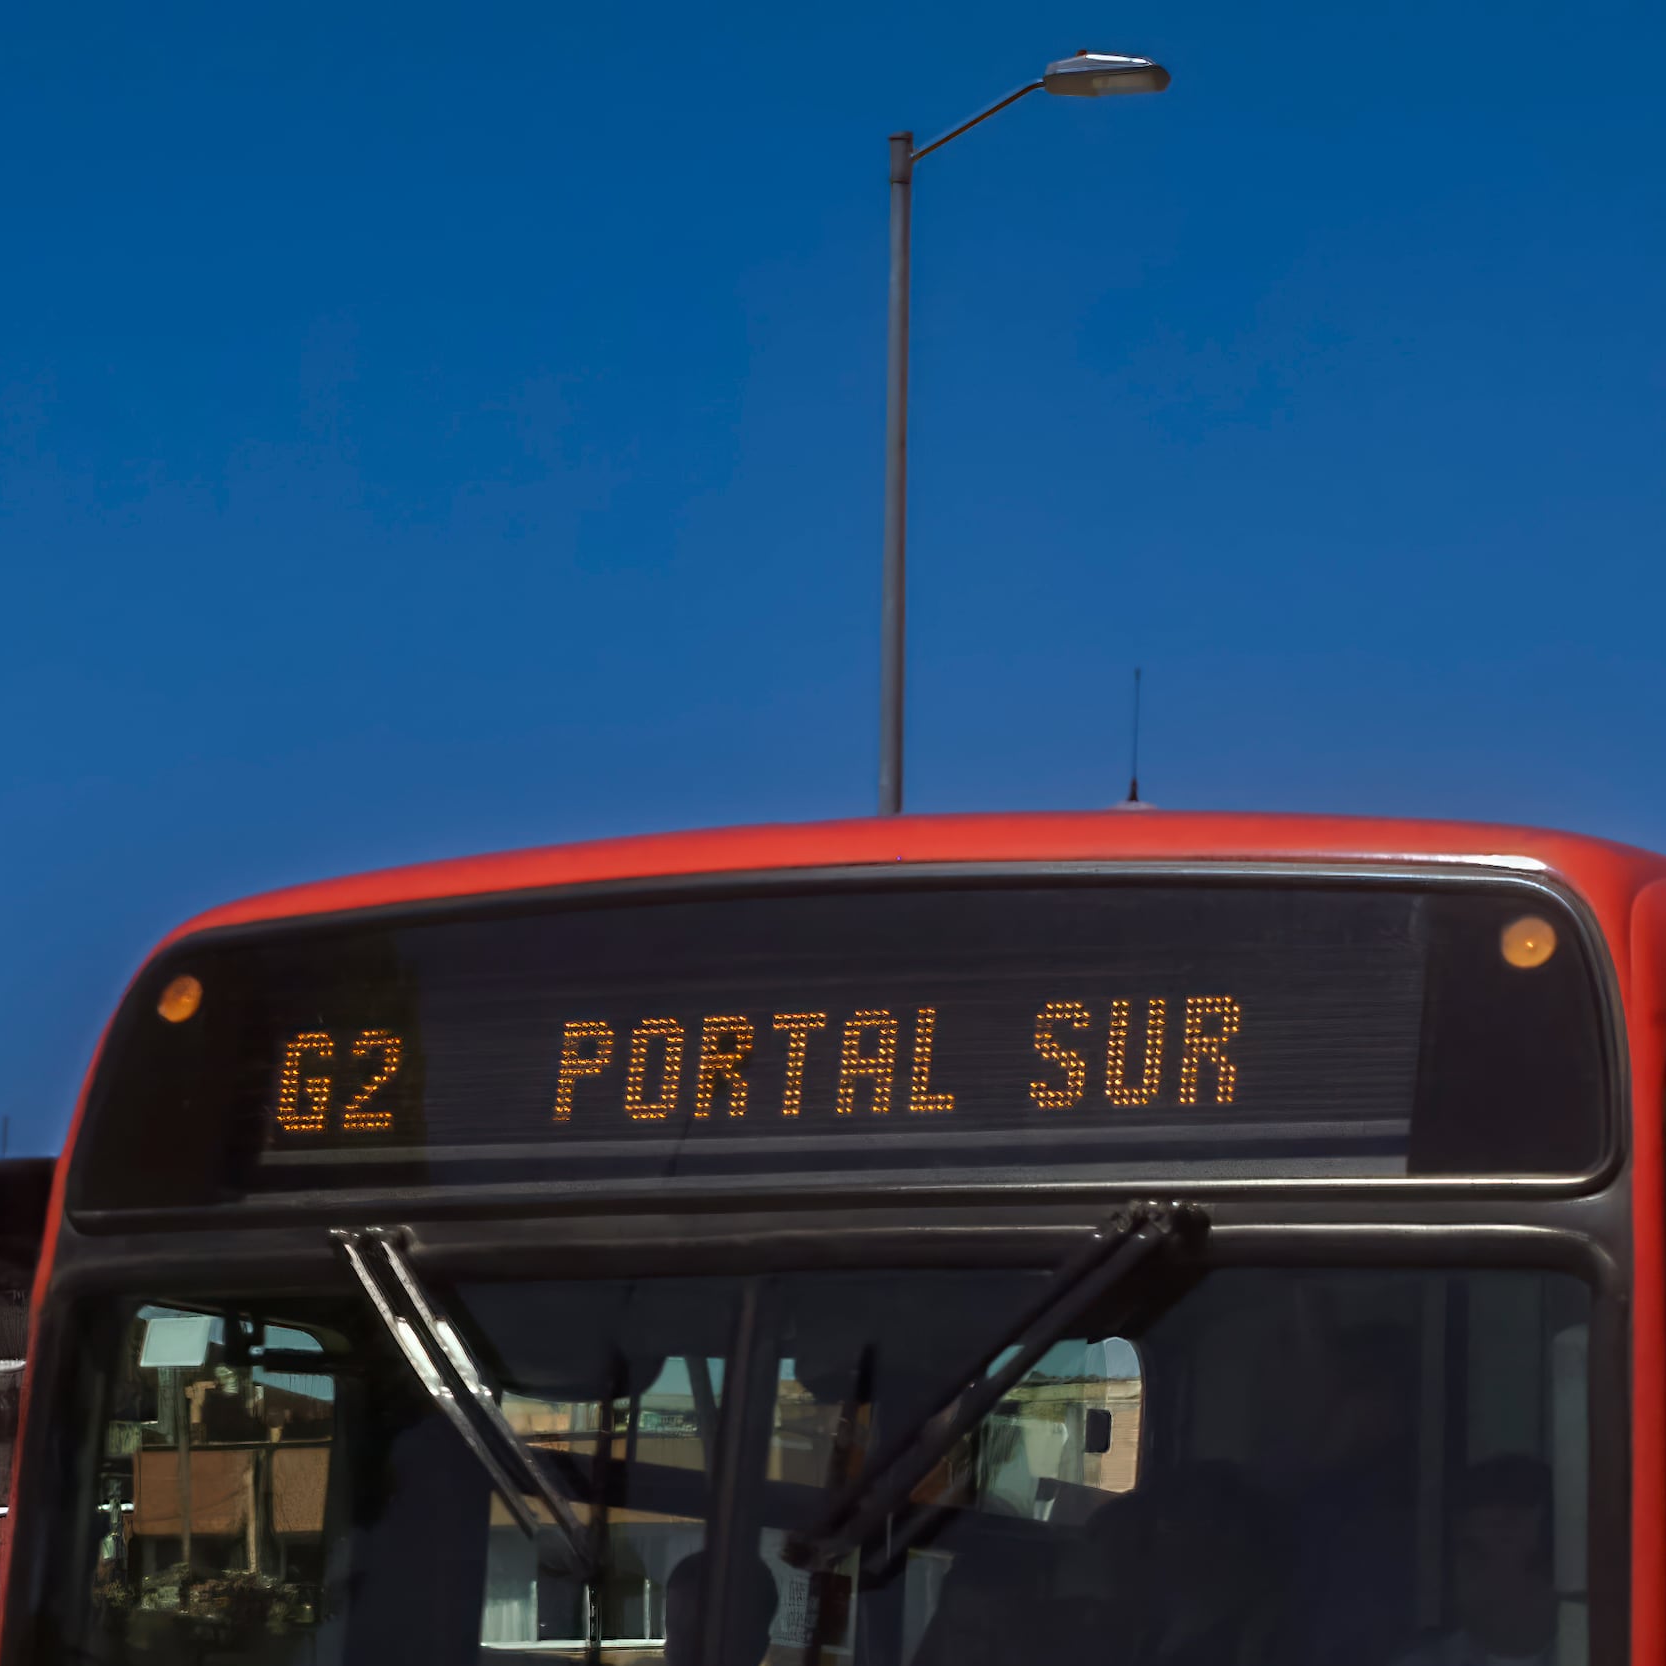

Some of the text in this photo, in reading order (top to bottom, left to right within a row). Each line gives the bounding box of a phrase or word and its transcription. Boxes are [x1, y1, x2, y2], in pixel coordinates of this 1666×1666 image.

[276, 996, 1241, 1132] G2 PORTAL SUR
